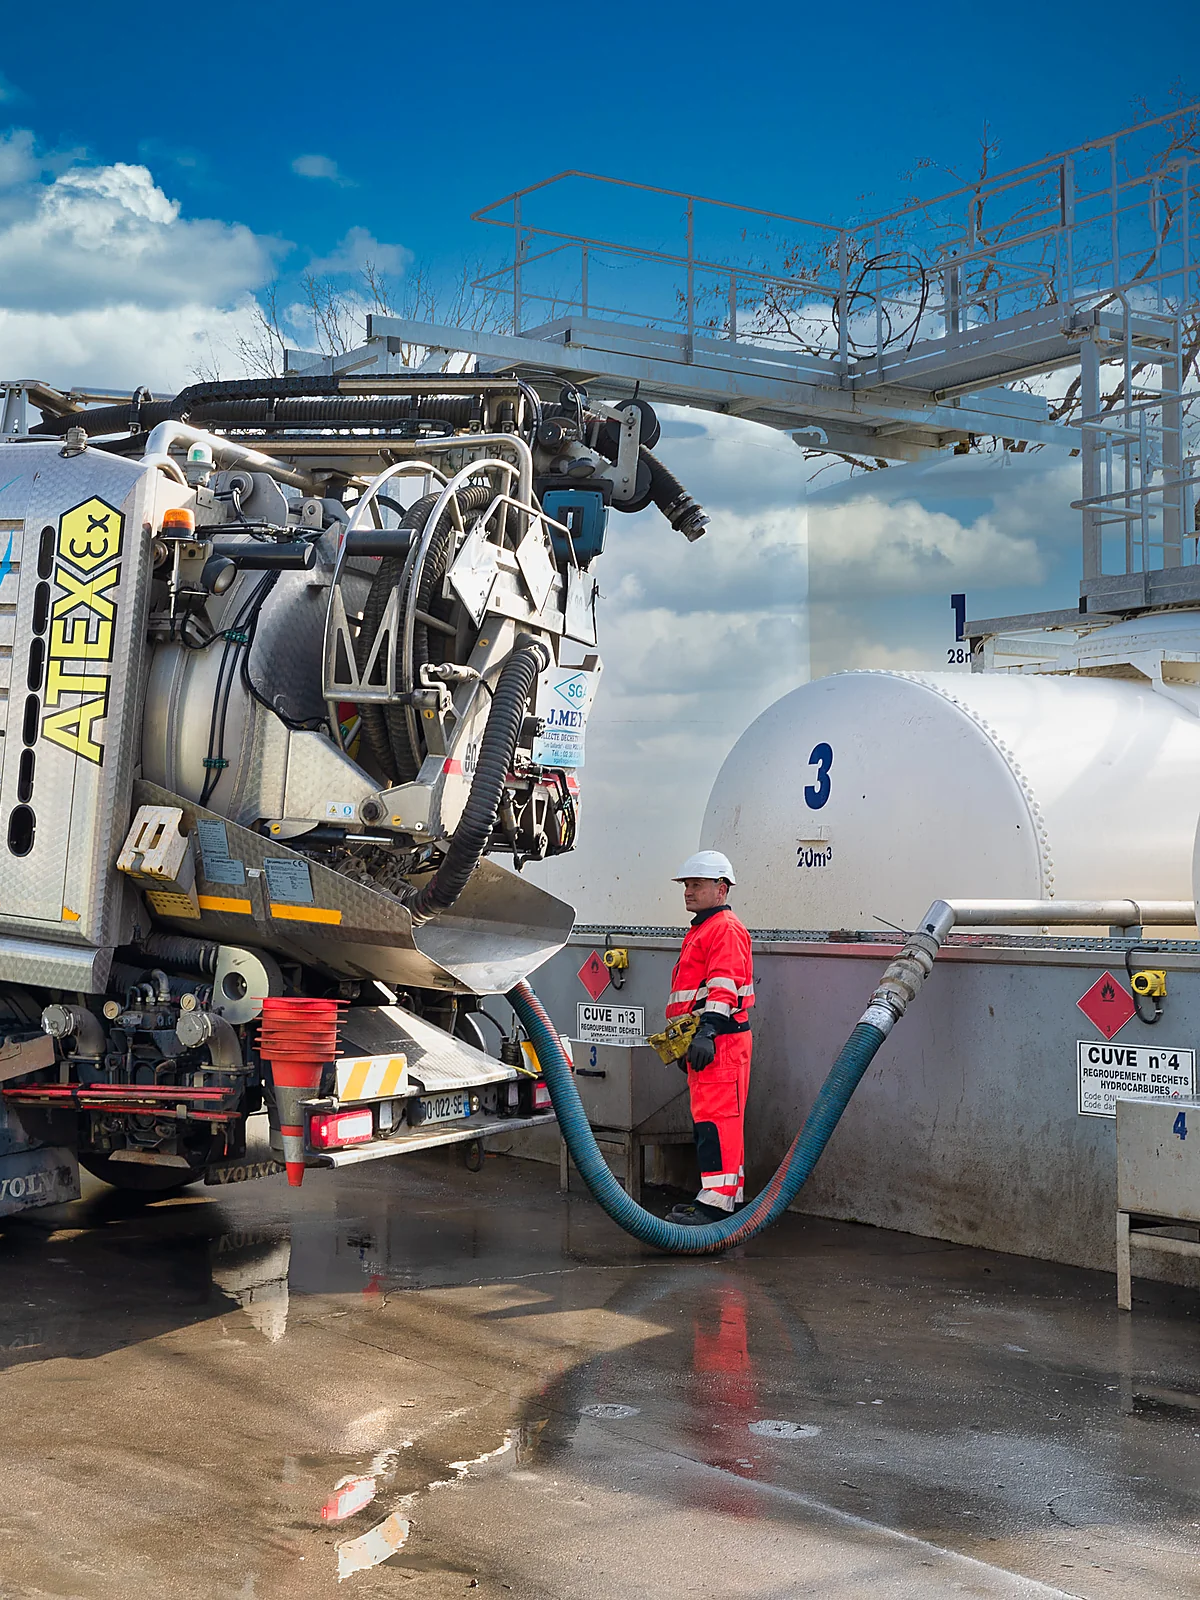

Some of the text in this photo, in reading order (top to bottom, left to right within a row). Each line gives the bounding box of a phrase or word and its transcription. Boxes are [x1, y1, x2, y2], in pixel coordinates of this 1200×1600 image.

[950, 593, 966, 643] 1
[41, 562, 122, 767] ATEX
[803, 742, 834, 811] 3
[584, 1007, 636, 1024] CUVE n°3
[581, 1022, 618, 1034] REGROUPEMENT
[619, 1026, 641, 1036] DECHETS
[589, 1045, 597, 1067] 3
[1088, 1046, 1180, 1071] CUVE n°4
[1083, 1068, 1189, 1086] REGROUPEMENT DECHETS
[1083, 1091, 1102, 1101] Code
[1100, 1080, 1171, 1095] HYDROCARBURES
[1083, 1100, 1102, 1110] Code
[1172, 1111, 1188, 1141] 4
